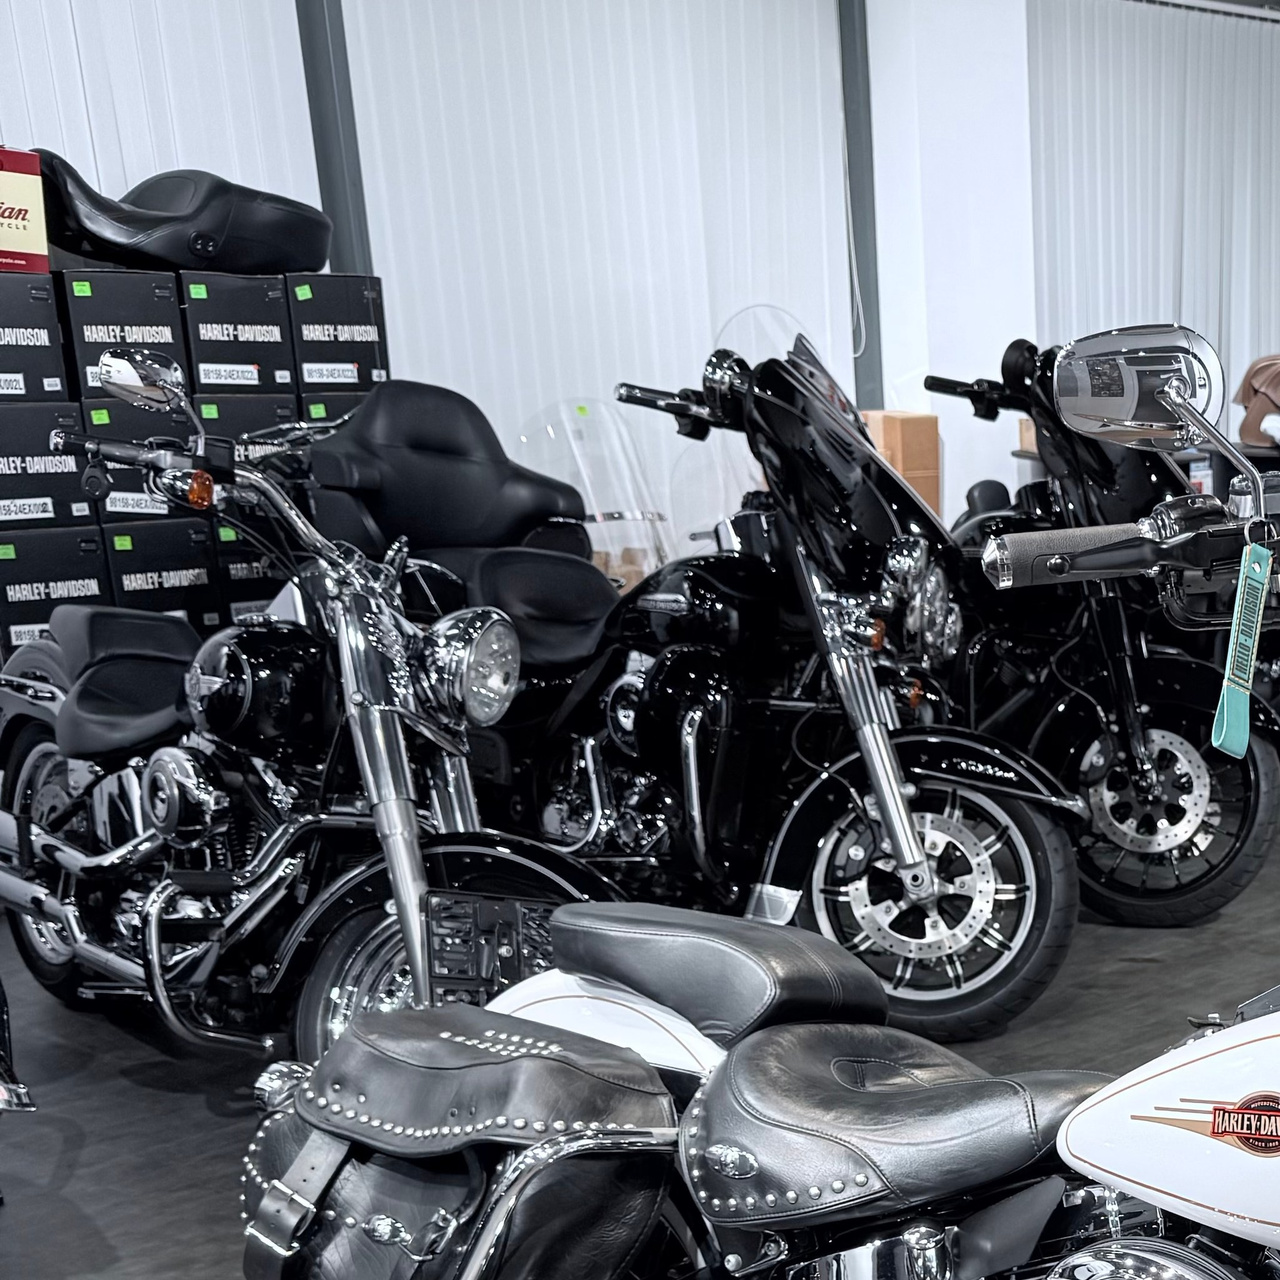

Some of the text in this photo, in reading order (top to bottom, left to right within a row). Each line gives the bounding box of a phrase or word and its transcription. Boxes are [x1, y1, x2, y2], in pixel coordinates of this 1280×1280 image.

[83, 325, 173, 343] HARLEY-DAVIDSON
[199, 324, 281, 342] HARLEY-DAVIDSON
[302, 324, 379, 342] HARLEY-DAVIDSON
[122, 568, 208, 591] HARLEY-DAVIDSON
[6, 578, 100, 602] HARLEY-DAVIDSON
[1235, 584, 1261, 675] HELLO DAVIDSON
